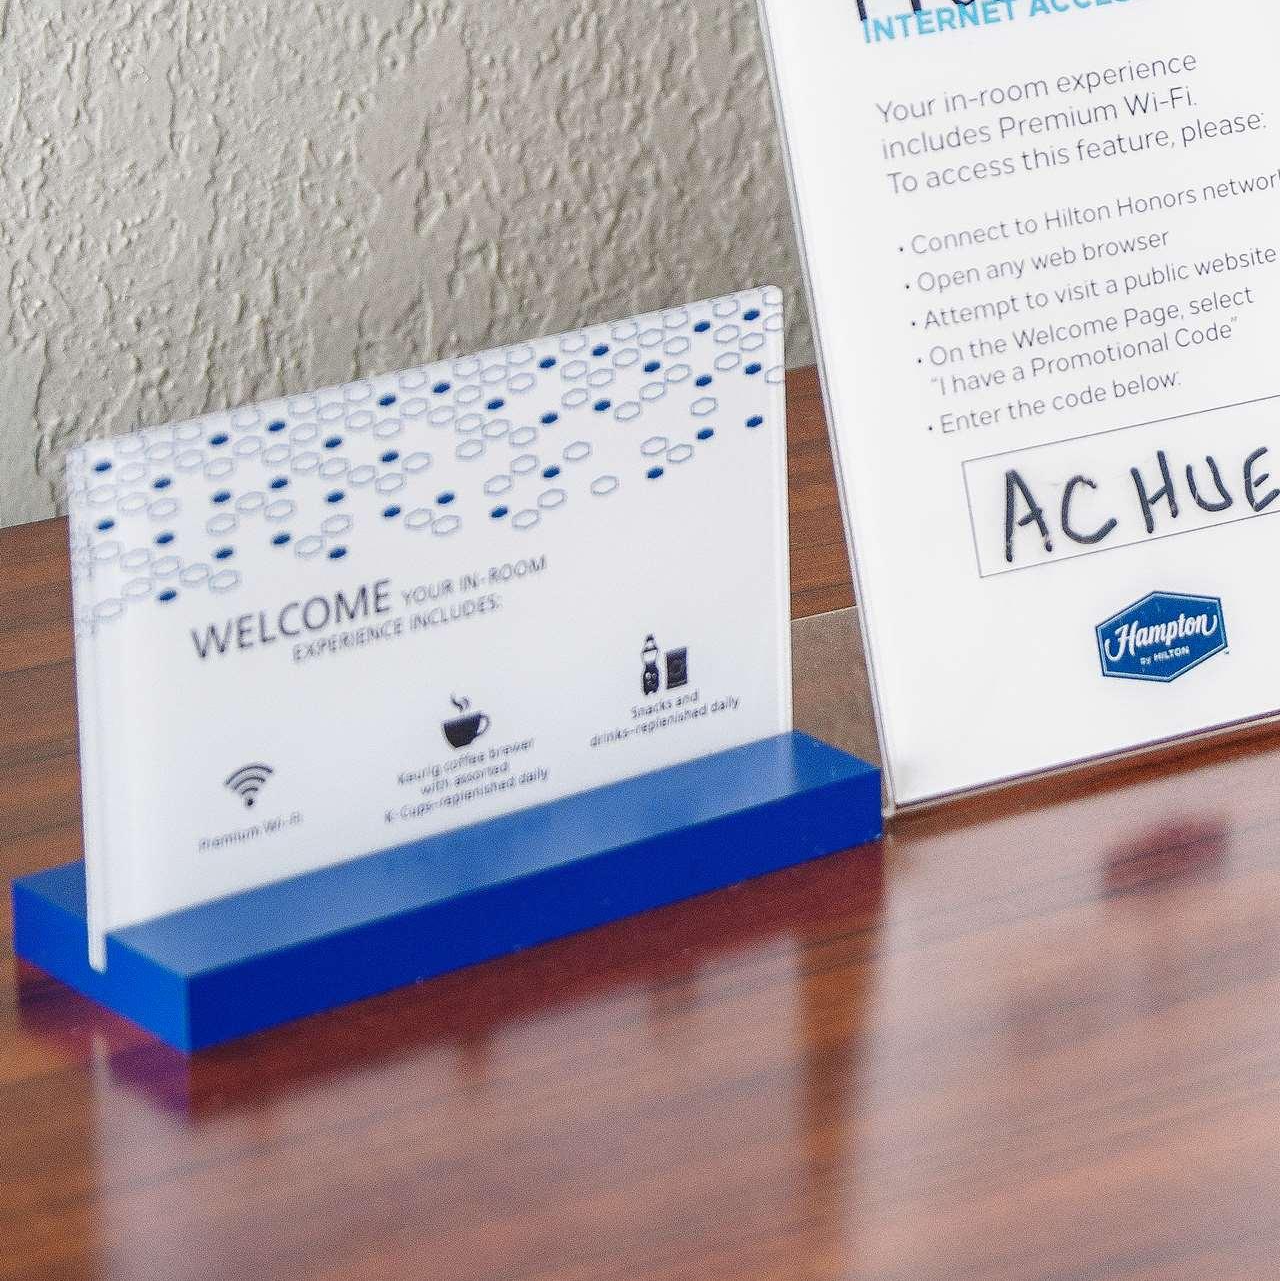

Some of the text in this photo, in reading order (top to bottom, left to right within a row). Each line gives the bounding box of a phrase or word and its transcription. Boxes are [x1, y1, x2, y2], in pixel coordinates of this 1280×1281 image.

[875, 51, 1198, 125] Your in-room experience
[882, 85, 1198, 161] includes Premium Wi-Fi.
[886, 110, 1267, 195] To access this feature, please:
[910, 221, 1010, 256] Connect
[1015, 215, 1039, 237] to
[1045, 201, 1111, 232] Hilton
[1116, 184, 1198, 219] Honors
[916, 229, 1170, 295] Open any web browser
[924, 245, 1278, 330] Attempt to visit a public website
[928, 285, 1254, 367] On the Welcome Page, select
[951, 369, 1006, 395] have
[1011, 367, 1026, 383] a
[1031, 333, 1170, 377] Promotional
[939, 371, 1182, 435] Enter the code below:
[190, 555, 549, 661] WELCOME YOUR IN-ROOM
[1104, 612, 1218, 663] Hampton
[292, 620, 403, 664] EXPERIENCE
[1153, 645, 1191, 663] HILTON
[630, 687, 700, 720] Snacks and
[711, 694, 740, 714] daily
[442, 751, 486, 774] coffee
[488, 736, 536, 759] brewer
[518, 766, 550, 787] daily
[420, 776, 452, 797] with
[197, 825, 260, 855] Premium
